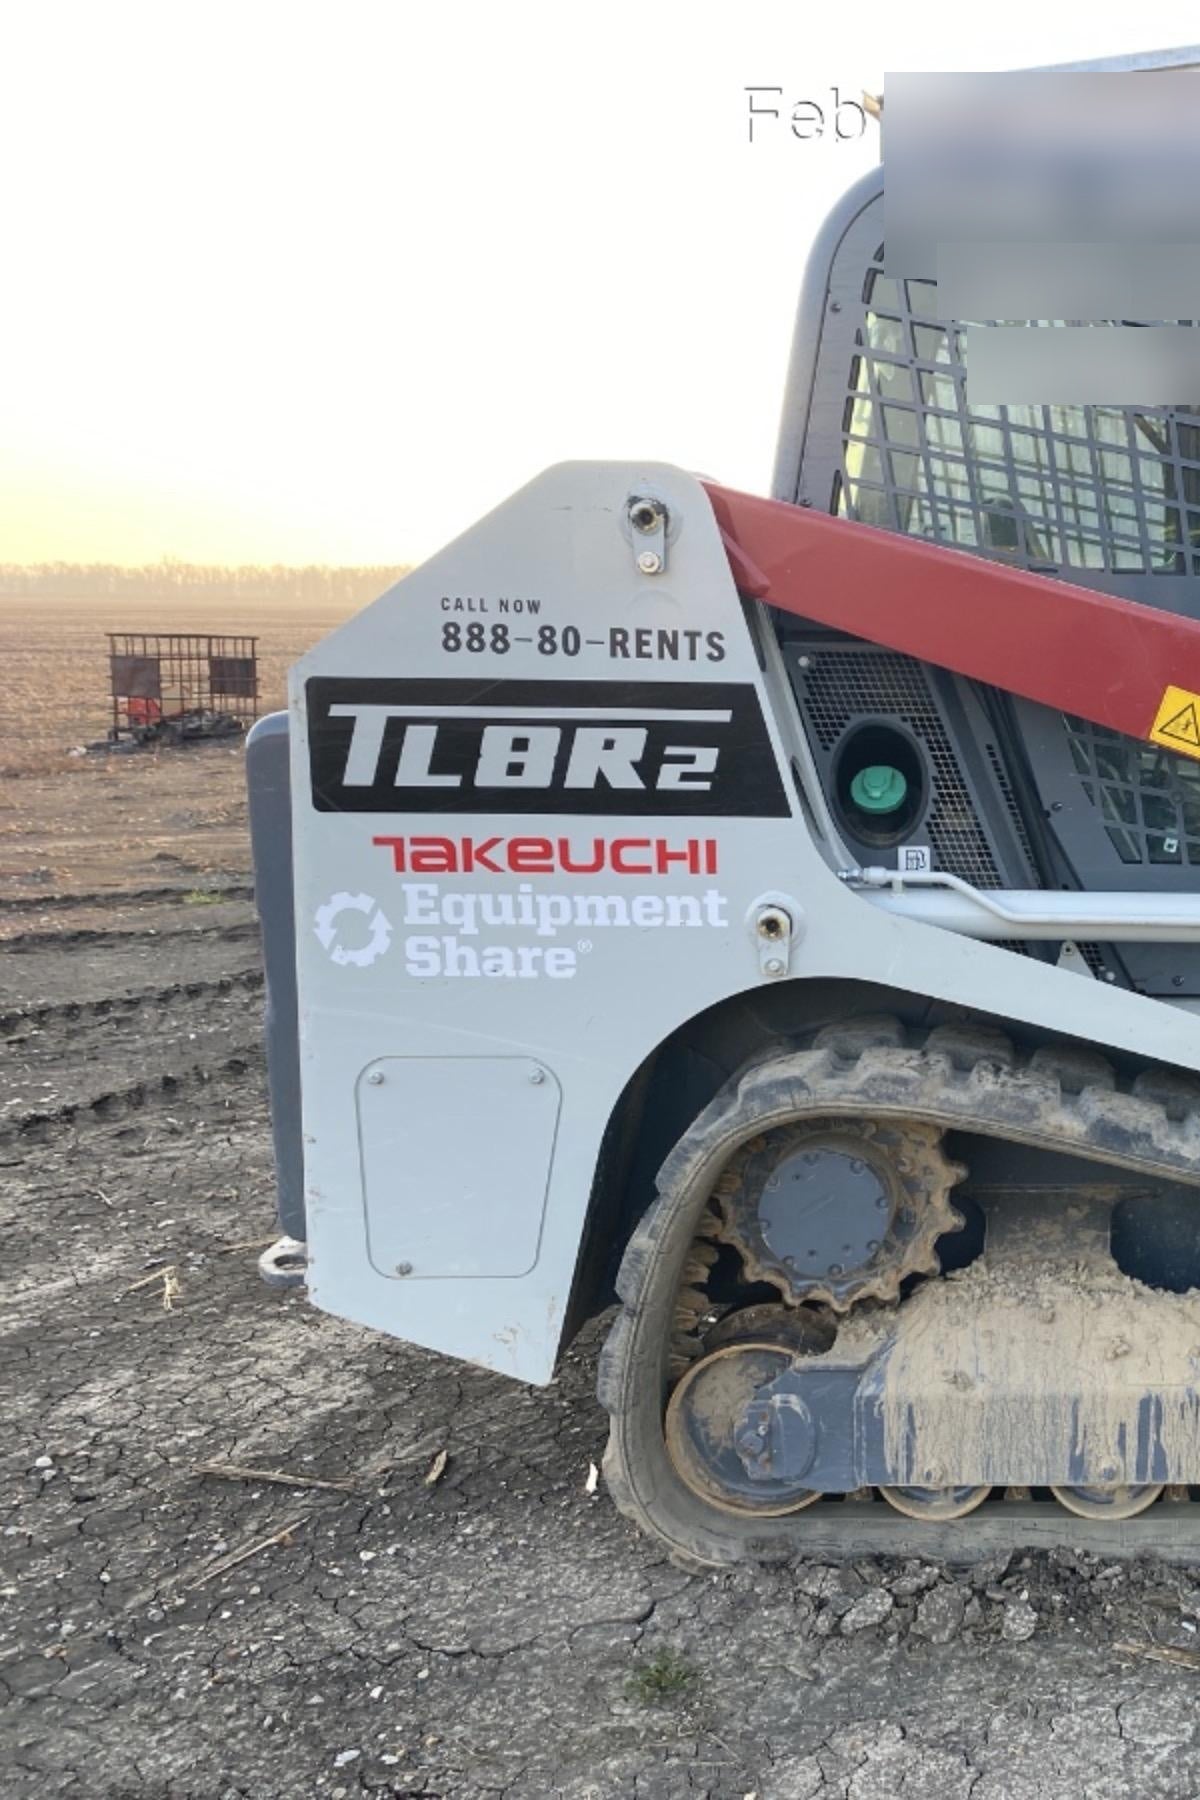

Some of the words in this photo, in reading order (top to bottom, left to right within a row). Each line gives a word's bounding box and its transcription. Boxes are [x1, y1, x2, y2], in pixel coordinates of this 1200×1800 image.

[441, 597, 488, 613] CALL
[499, 598, 541, 615] NOW
[441, 621, 726, 663] 888-80-RENTS
[328, 703, 733, 791] TL8R2
[402, 883, 729, 936] Equipment
